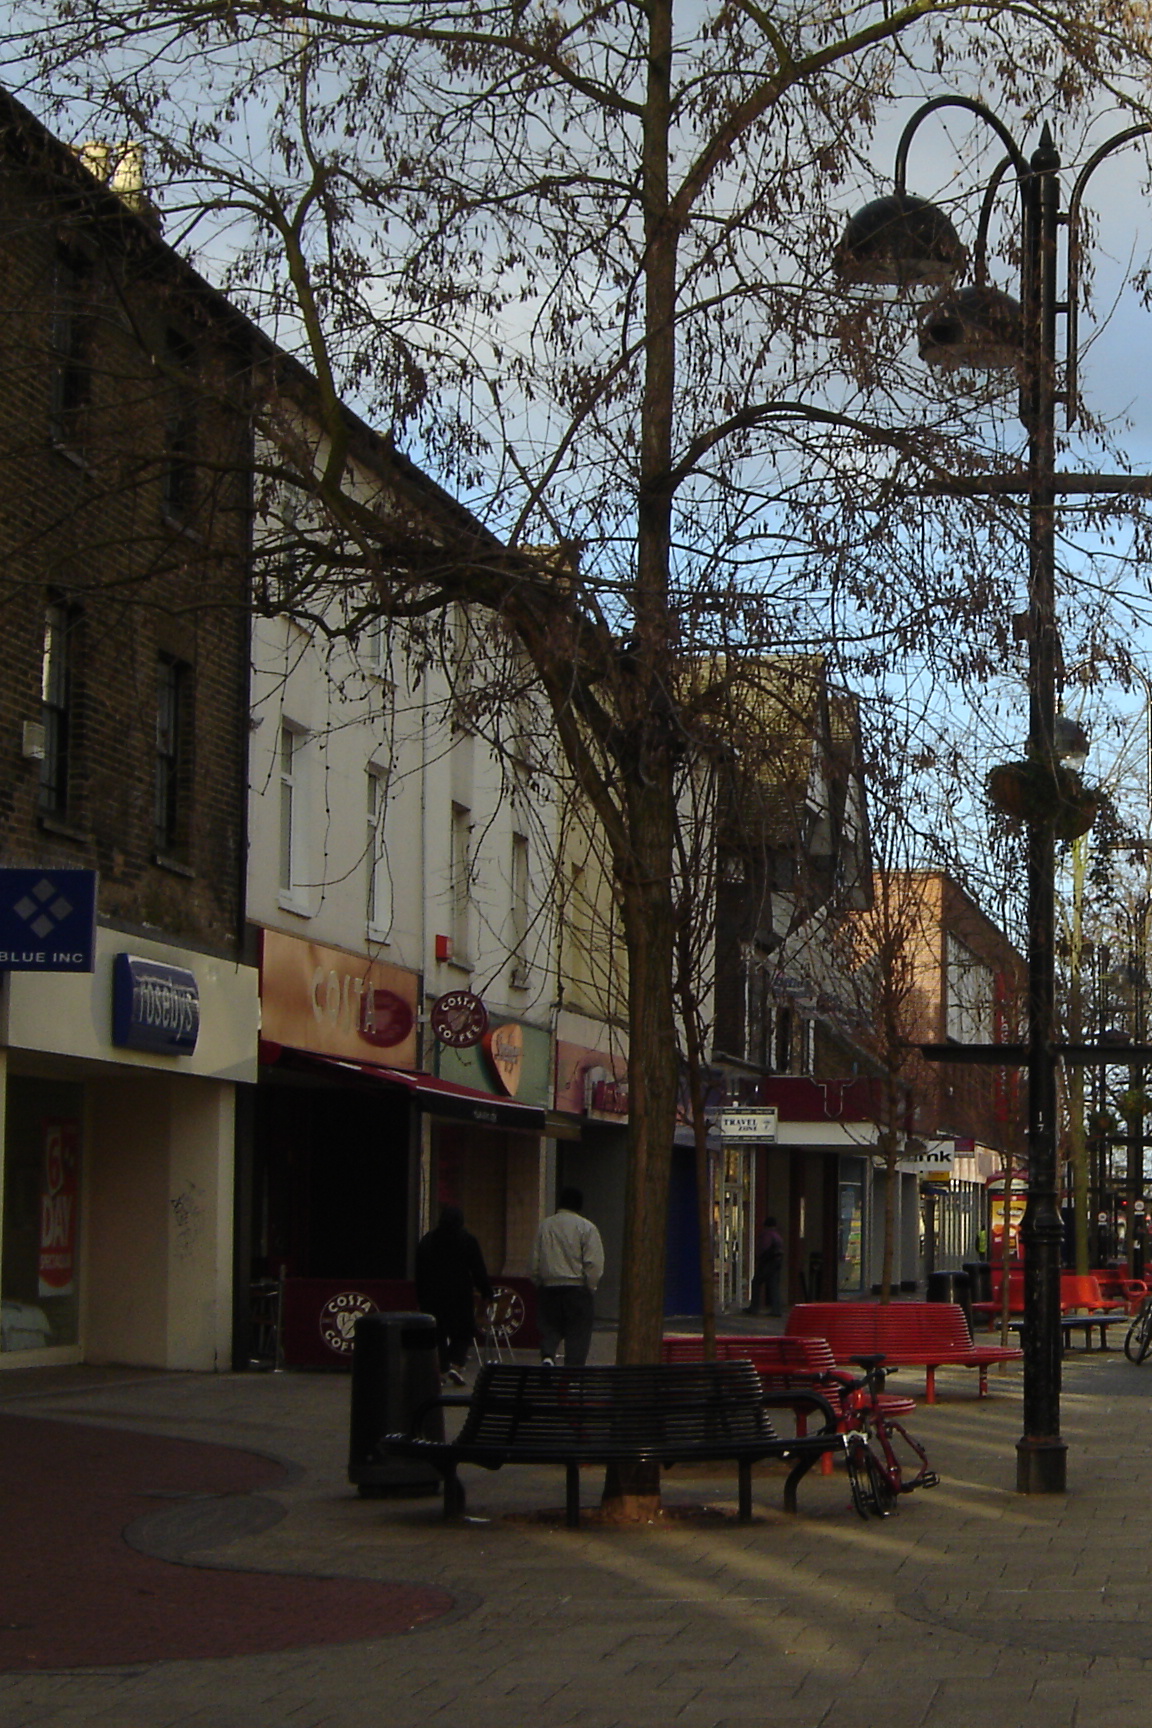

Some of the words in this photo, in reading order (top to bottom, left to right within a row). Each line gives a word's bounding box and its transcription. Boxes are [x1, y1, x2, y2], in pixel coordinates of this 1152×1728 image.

[53, 953, 83, 963] INC
[442, 996, 477, 1011] COSTA
[438, 1024, 480, 1042] COFFEE
[724, 1118, 757, 1126] TRAVEL
[328, 1295, 372, 1312] COSTA
